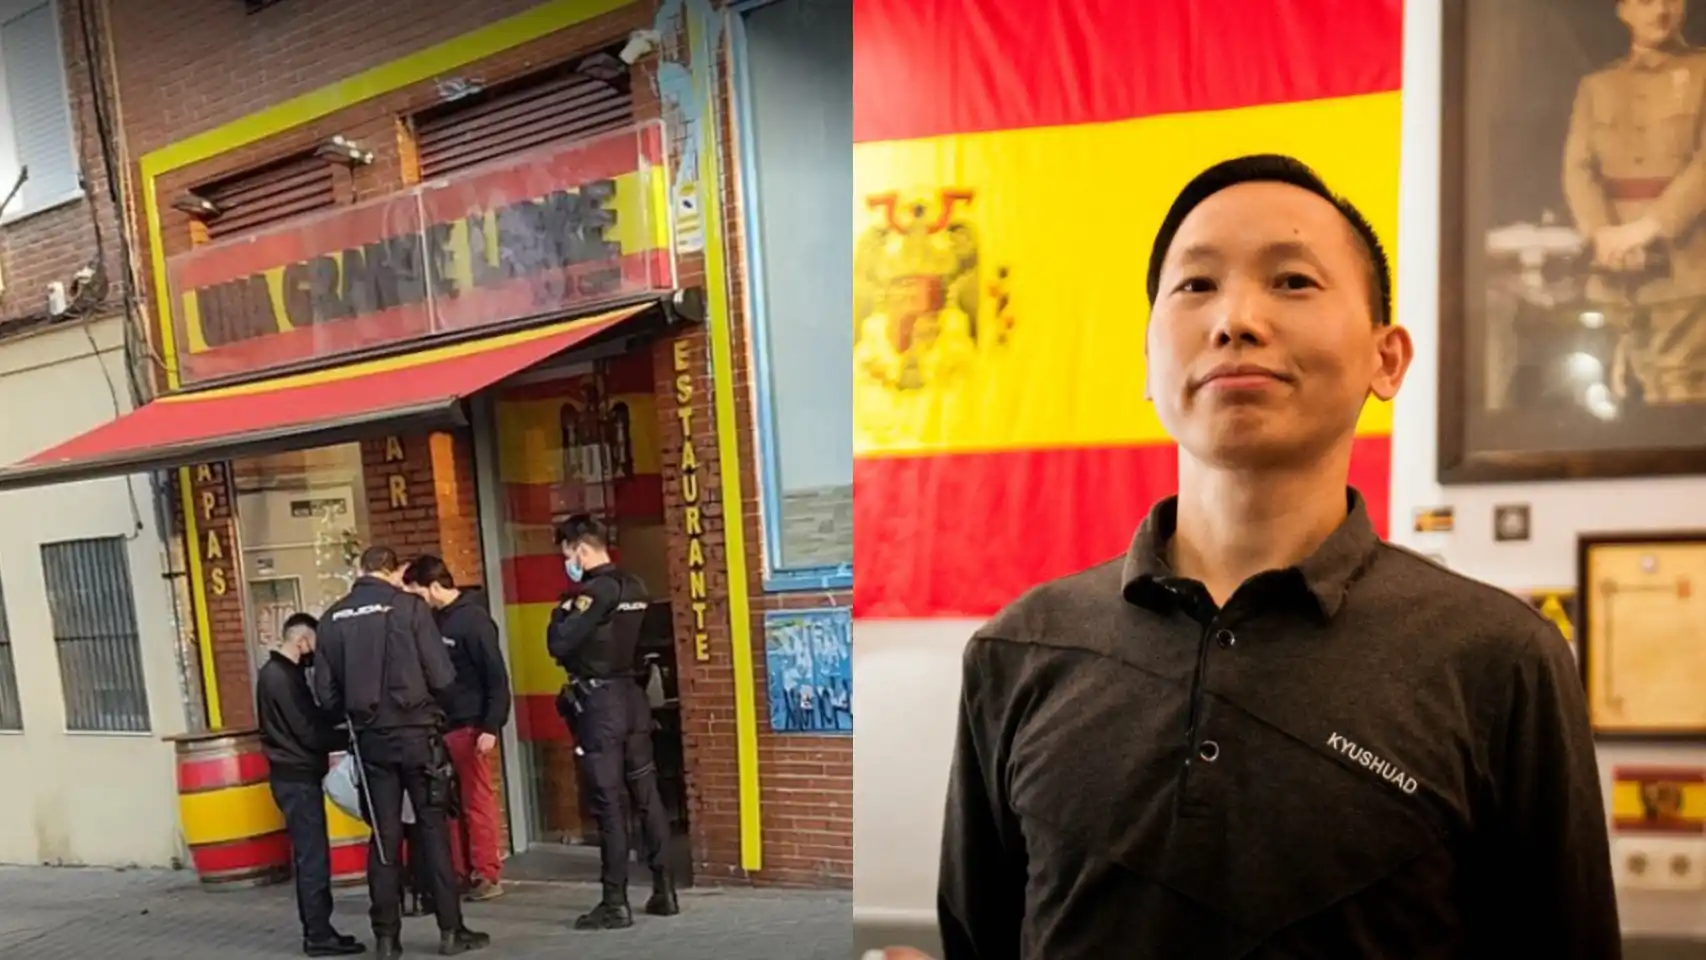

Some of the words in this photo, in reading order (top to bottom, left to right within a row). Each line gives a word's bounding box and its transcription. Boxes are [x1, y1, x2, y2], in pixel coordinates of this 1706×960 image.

[386, 435, 408, 508] AR
[673, 341, 709, 661] ESTAURANTE
[197, 464, 226, 596] APAS
[1326, 731, 1419, 794] KYUSHUAD
